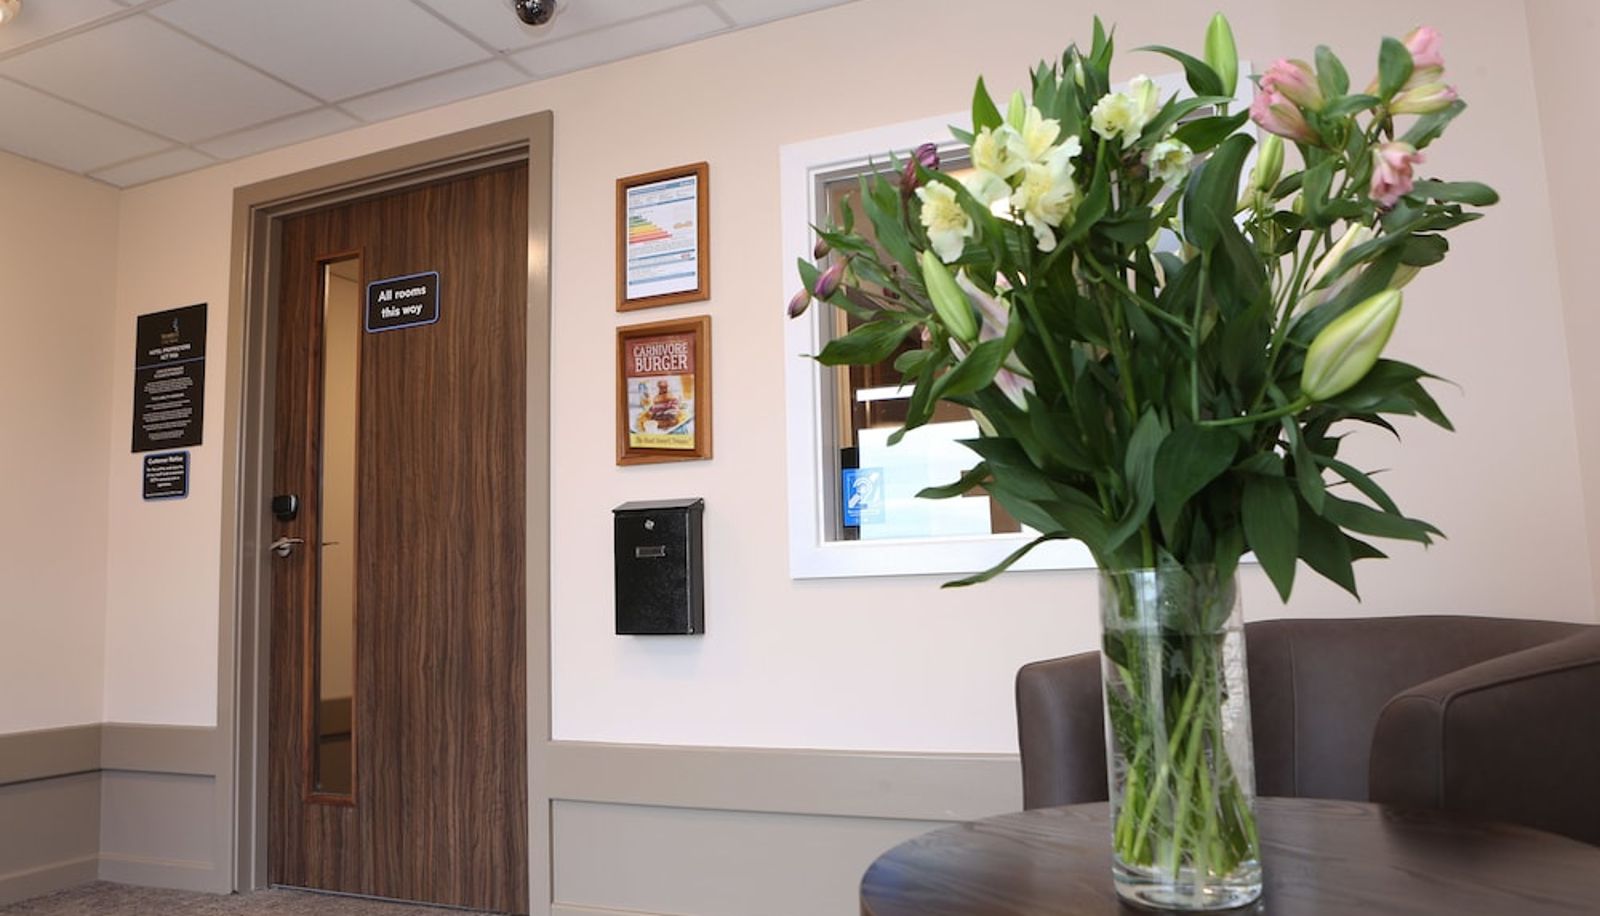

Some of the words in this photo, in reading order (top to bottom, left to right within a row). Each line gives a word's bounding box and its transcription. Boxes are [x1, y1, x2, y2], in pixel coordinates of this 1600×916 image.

[377, 289, 392, 302] All
[394, 286, 427, 299] rooms
[381, 306, 400, 318] this
[402, 304, 423, 315] way
[633, 341, 688, 357] CARNIVORE
[635, 354, 688, 372] BURGER
